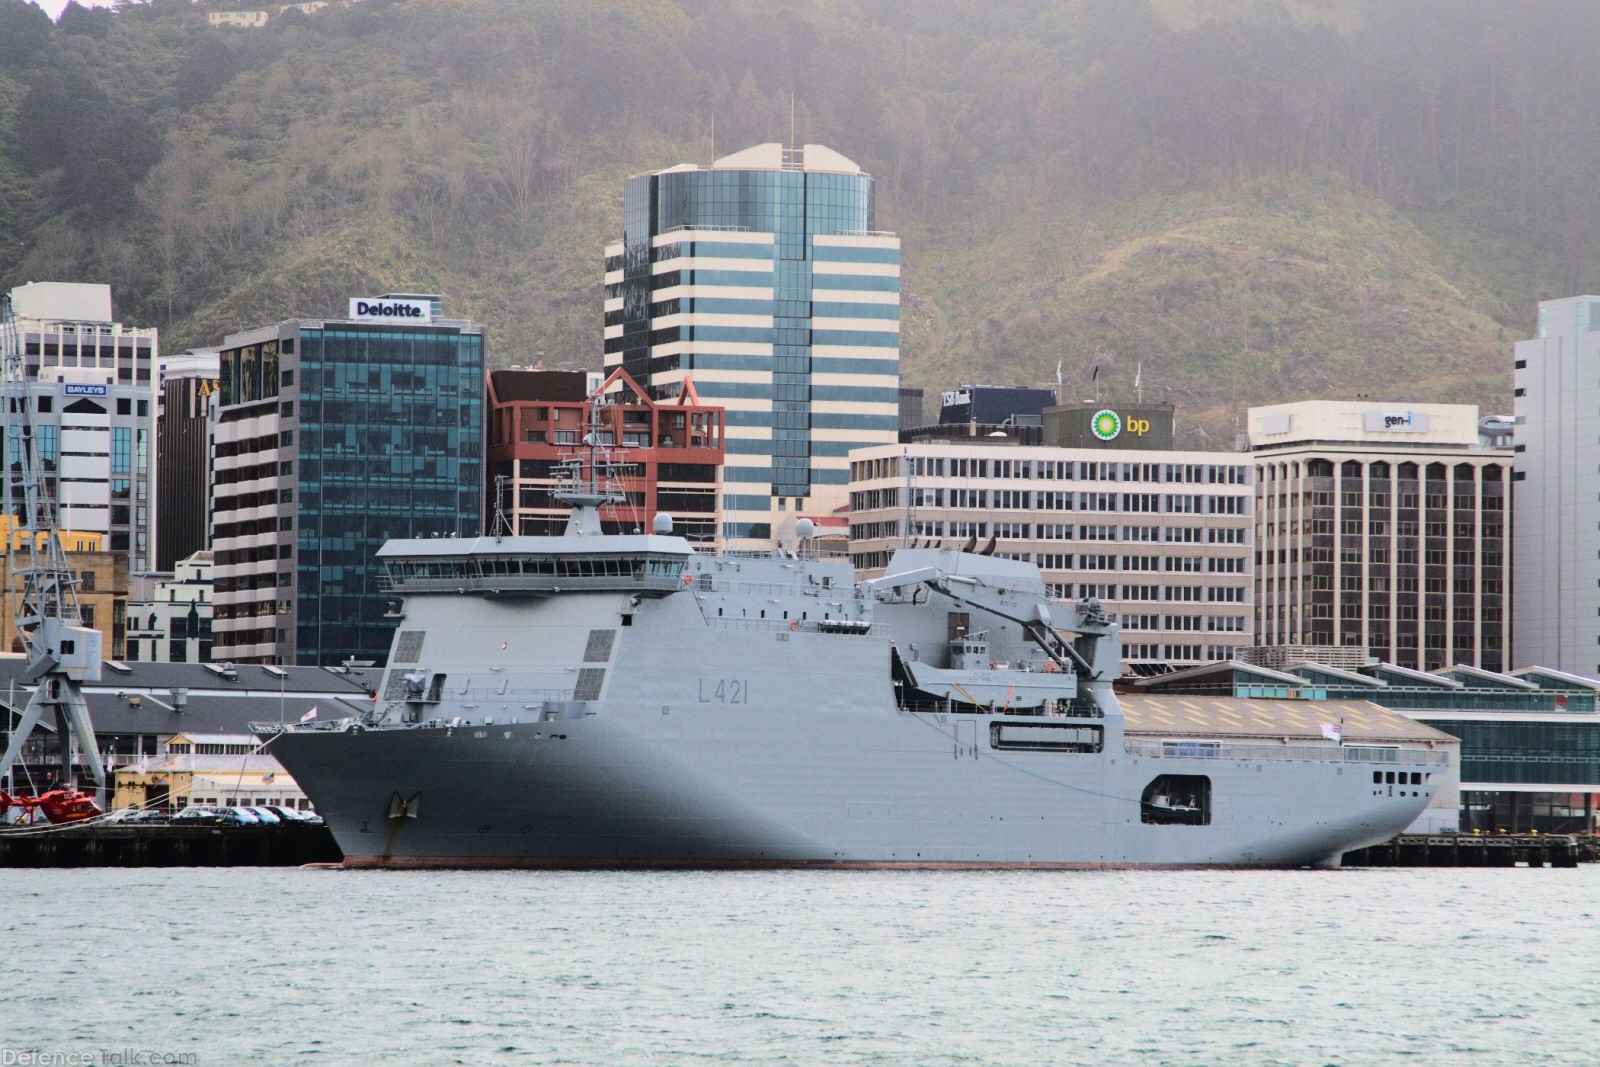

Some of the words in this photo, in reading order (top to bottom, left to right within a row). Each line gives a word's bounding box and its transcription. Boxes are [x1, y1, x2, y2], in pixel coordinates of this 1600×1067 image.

[67, 385, 105, 394] BAYLEYS
[955, 389, 971, 405] Bank
[1127, 415, 1150, 437] bp
[1384, 410, 1412, 428] gen-i
